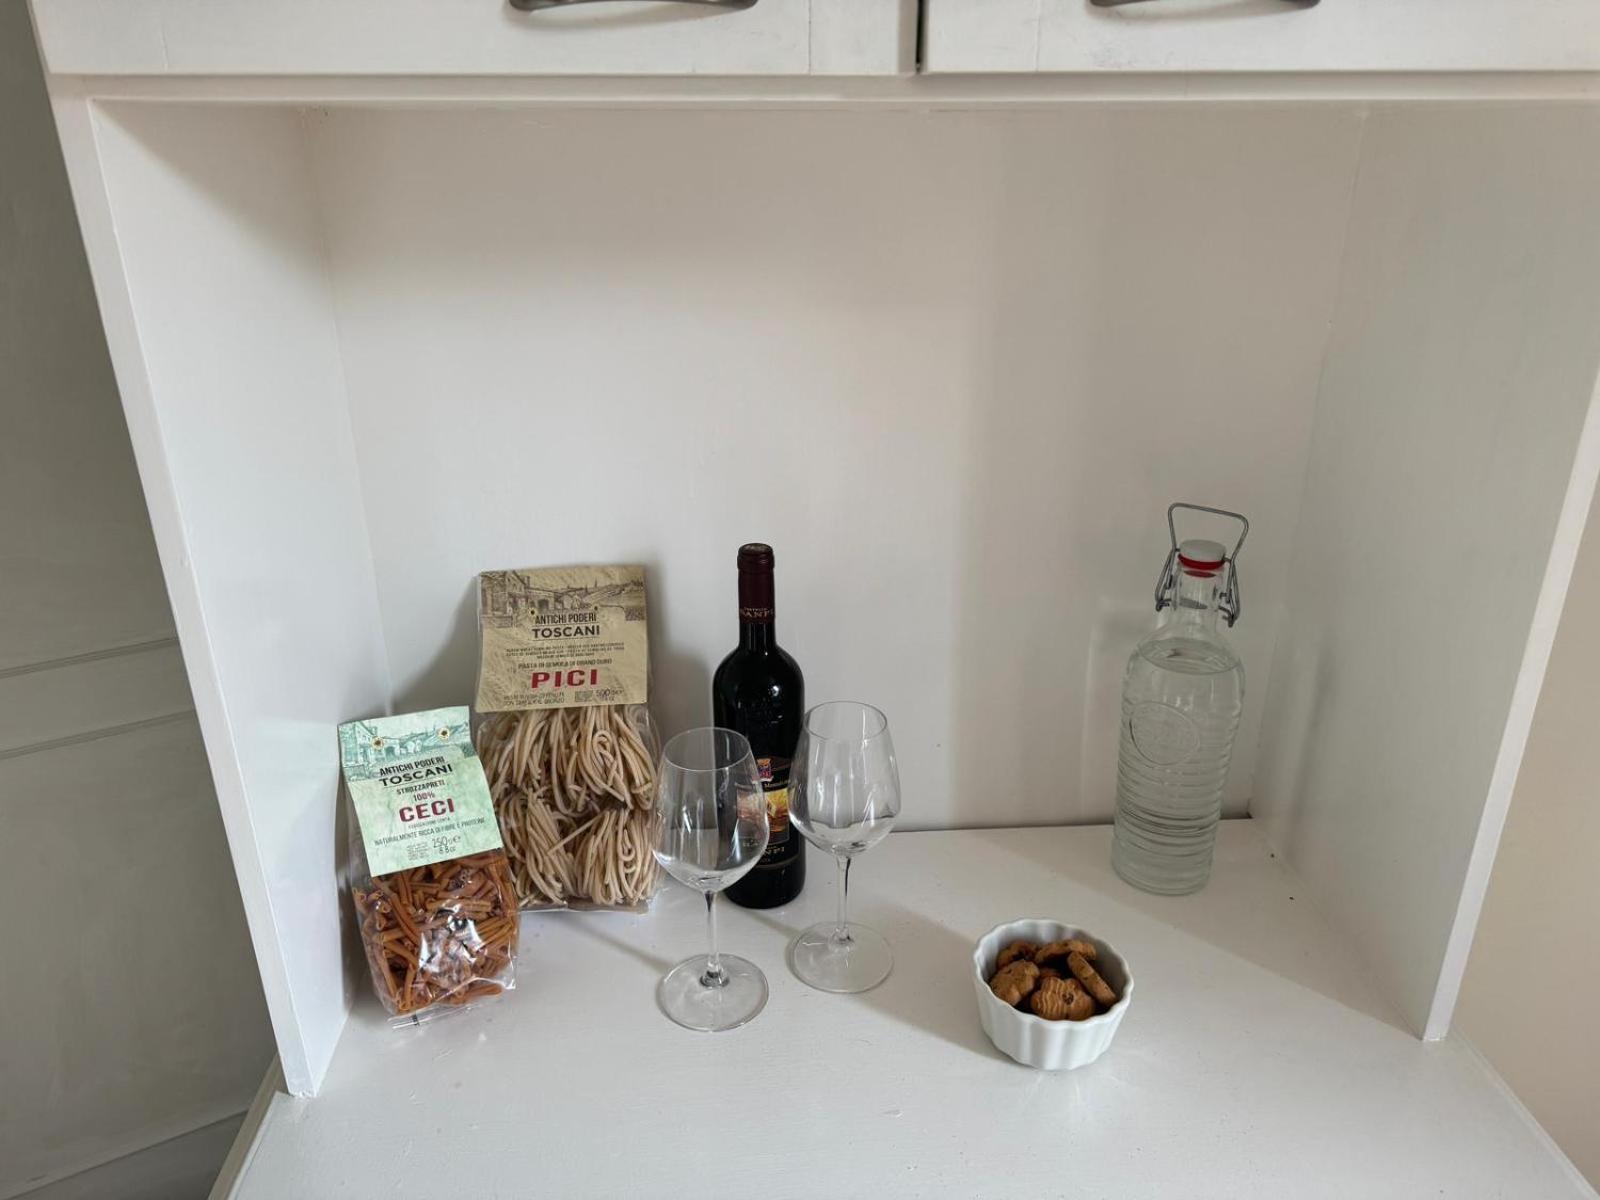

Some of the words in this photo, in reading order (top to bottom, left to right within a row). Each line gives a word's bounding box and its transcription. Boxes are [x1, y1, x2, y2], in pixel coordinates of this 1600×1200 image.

[535, 614, 566, 624] ANTICHI
[568, 612, 597, 623] PODERI
[532, 626, 600, 638] TOSCANI
[531, 669, 598, 689] PICI
[378, 764, 453, 786] TOSCANI
[380, 762, 414, 776] ANTICHI
[414, 756, 445, 768] PODERI
[396, 780, 446, 795] STROZZAPRETI
[399, 798, 455, 822] CECI
